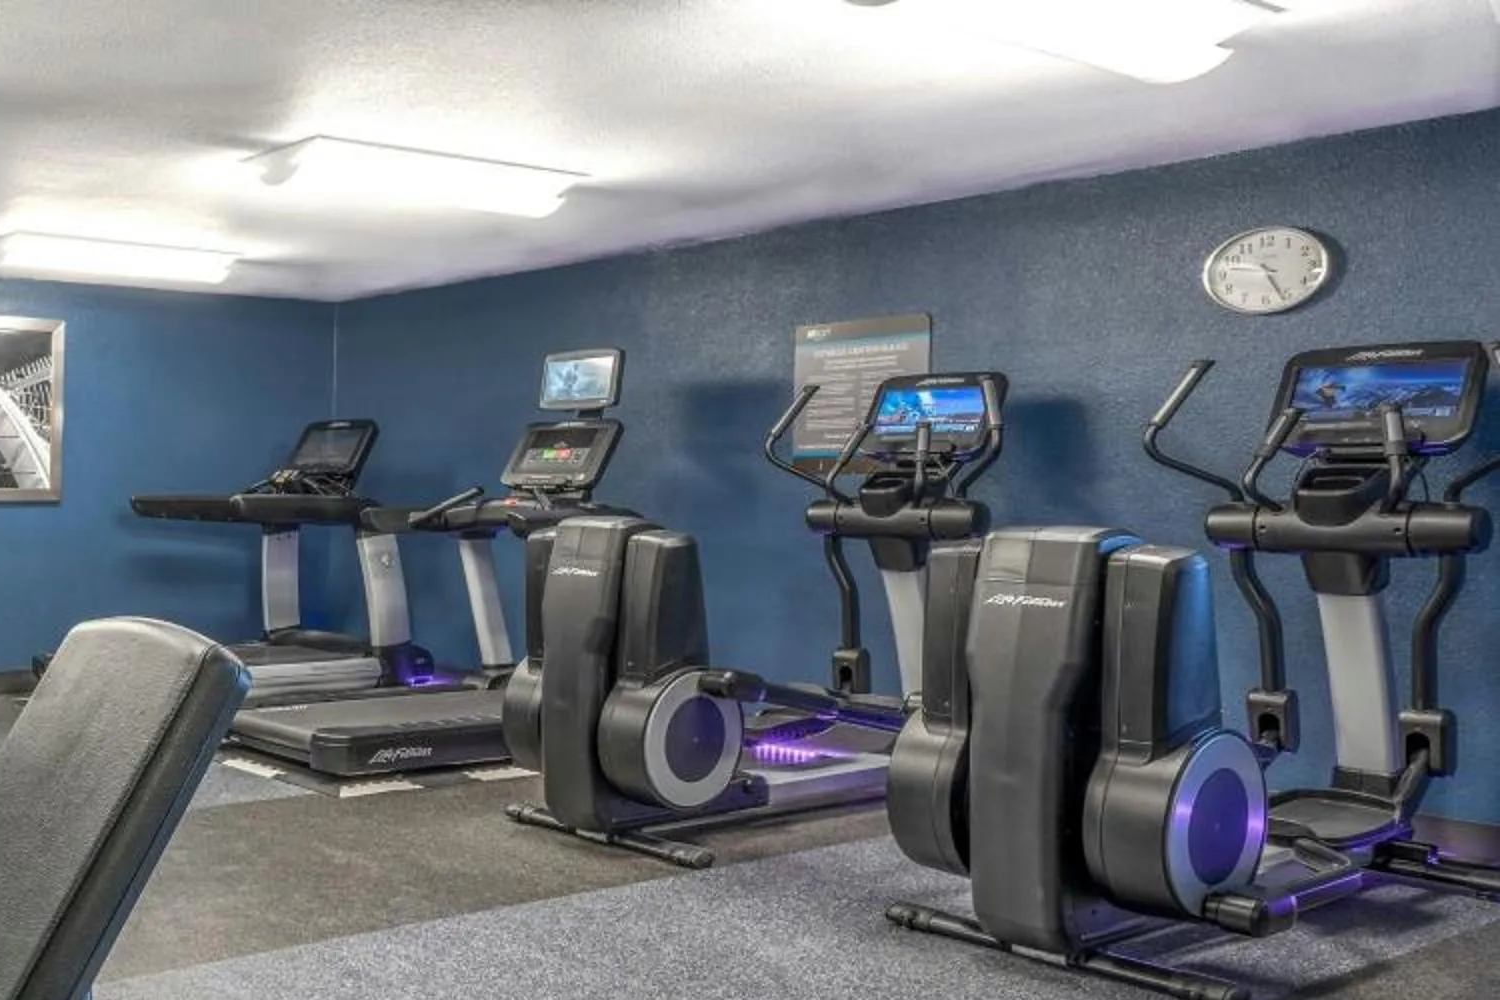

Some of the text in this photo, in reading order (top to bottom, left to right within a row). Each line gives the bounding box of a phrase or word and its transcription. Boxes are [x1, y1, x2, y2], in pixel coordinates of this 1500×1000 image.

[1260, 234, 1276, 248] 12
[1239, 243, 1252, 255] 11
[1224, 255, 1241, 266] 10
